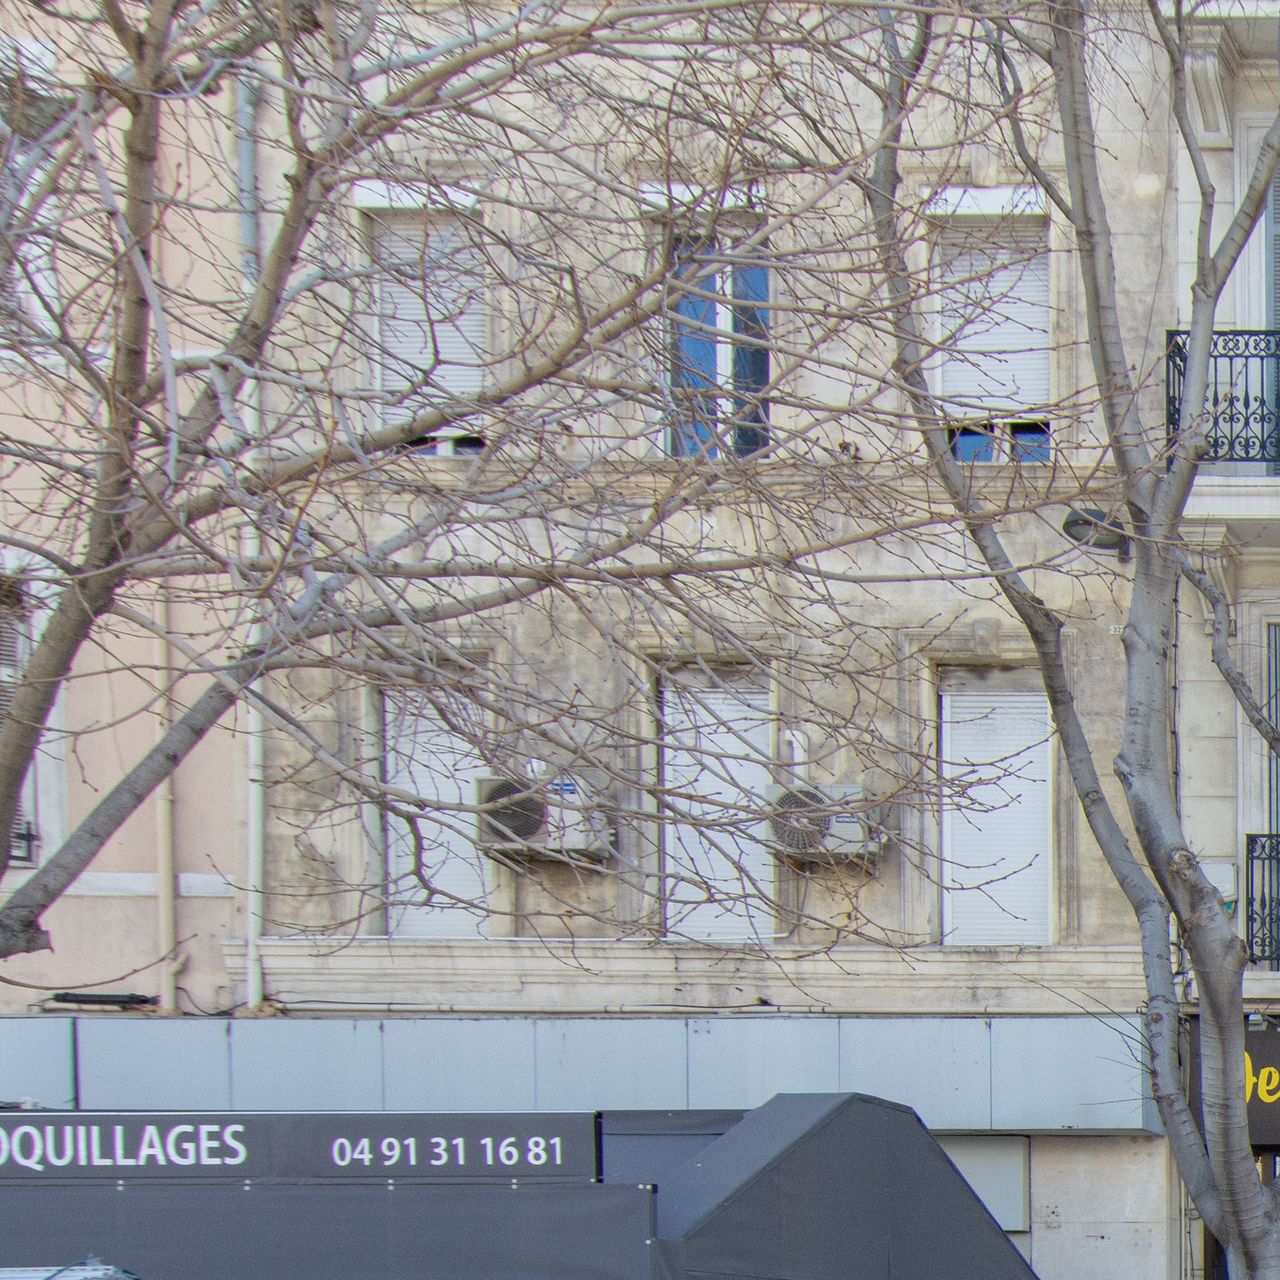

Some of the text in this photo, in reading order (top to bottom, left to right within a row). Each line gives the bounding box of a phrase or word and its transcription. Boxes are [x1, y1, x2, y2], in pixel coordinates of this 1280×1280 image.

[332, 1137, 563, 1166] 04 91 31 16 81
